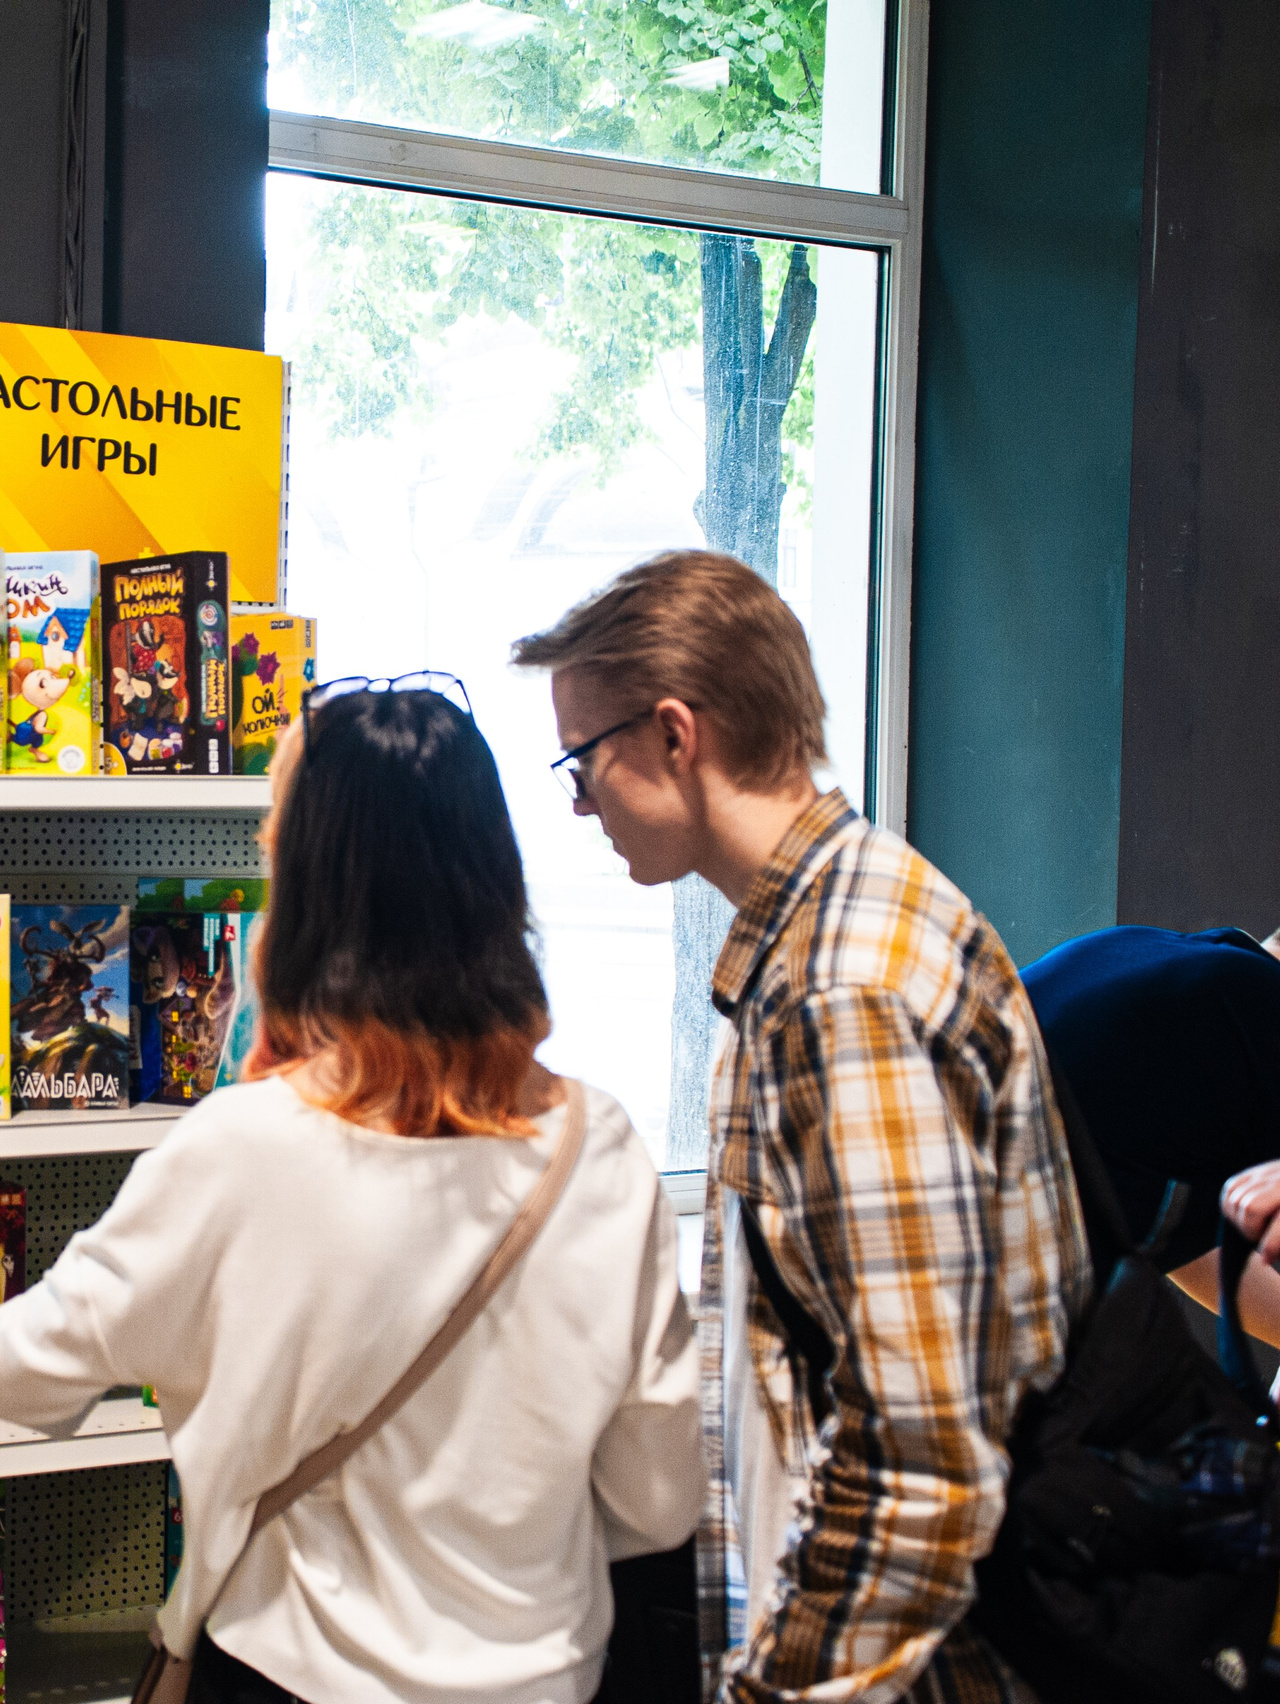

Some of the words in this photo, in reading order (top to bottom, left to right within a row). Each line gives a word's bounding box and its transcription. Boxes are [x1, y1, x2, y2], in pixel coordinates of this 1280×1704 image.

[41, 433, 157, 476] ИГРЫ
[115, 566, 185, 602] ПОЛНЫЙ
[7, 595, 50, 620] ОМ
[119, 597, 181, 620] ПОРЯДОК
